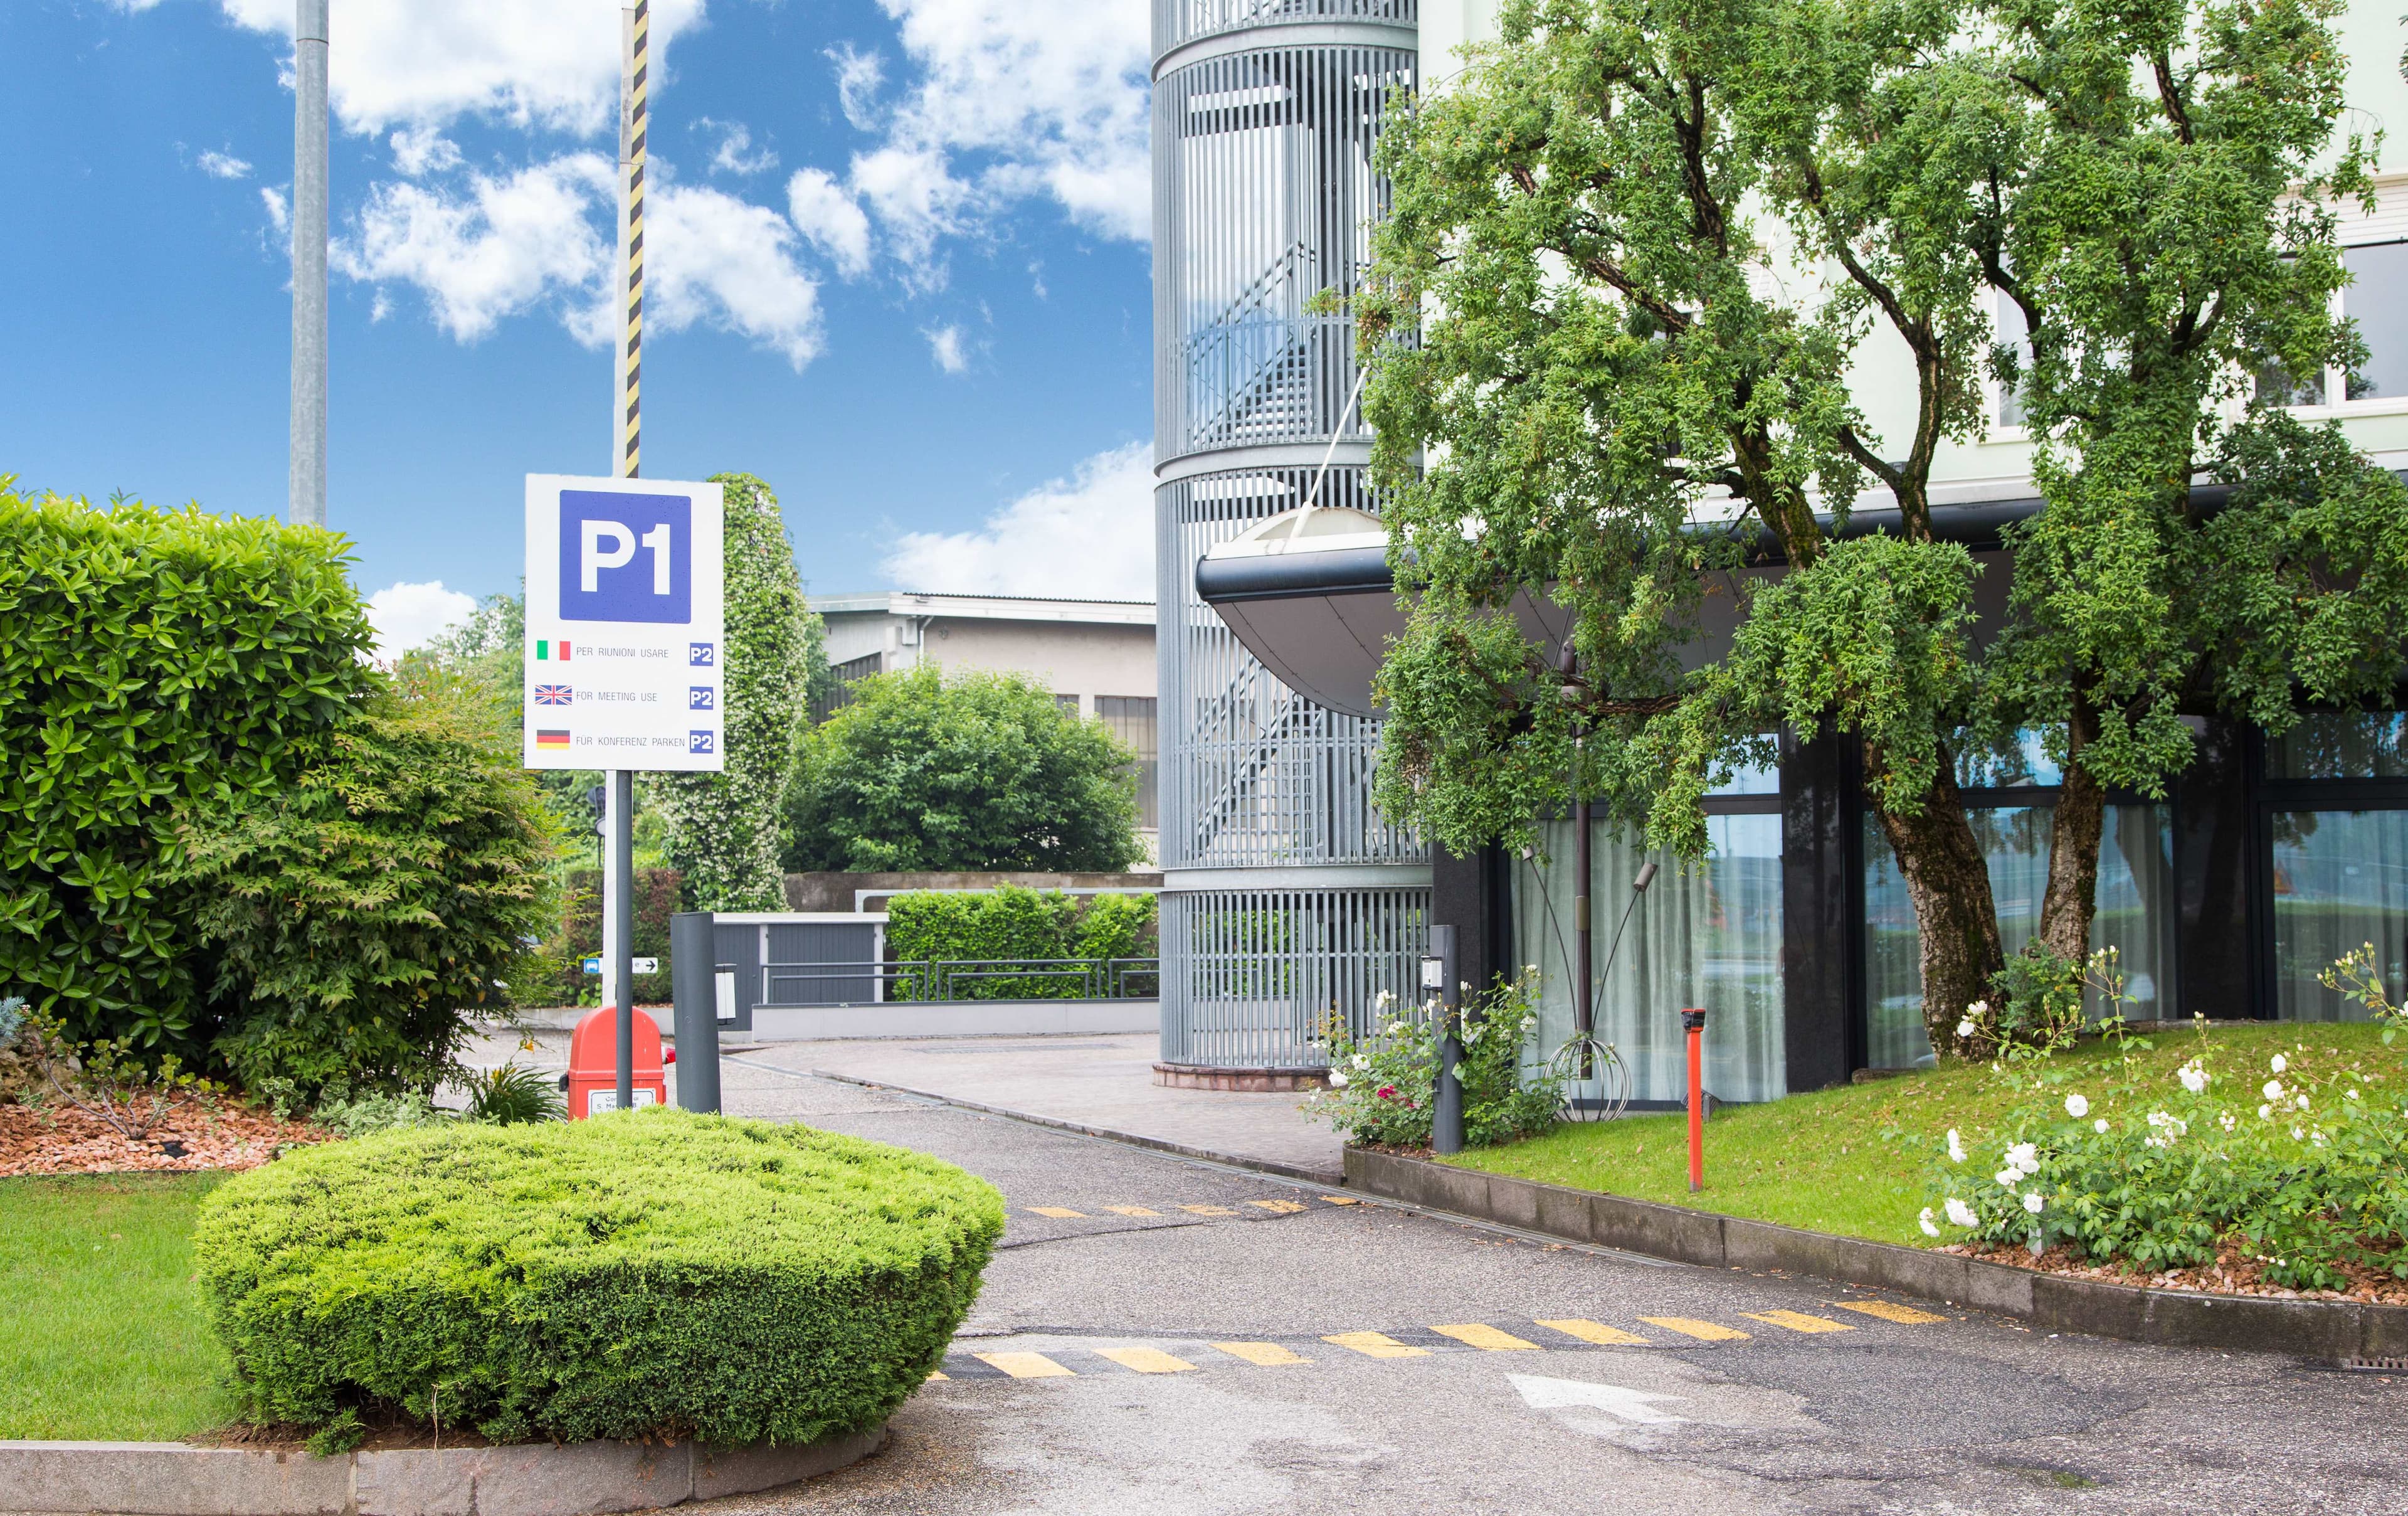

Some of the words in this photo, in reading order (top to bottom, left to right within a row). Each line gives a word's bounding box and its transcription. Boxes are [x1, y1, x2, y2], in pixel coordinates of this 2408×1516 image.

[581, 519, 670, 595] P1
[576, 647, 593, 655] PER
[598, 647, 635, 657] RIUNIONI
[640, 649, 669, 657] USARE
[691, 647, 712, 662] P2
[576, 692, 593, 700] FOR
[598, 692, 635, 701] MEETING
[640, 693, 657, 701] USE
[691, 691, 712, 706] P2
[598, 737, 647, 746] KONFERENZ
[652, 738, 685, 746] PARKEN
[691, 734, 712, 750] P2
